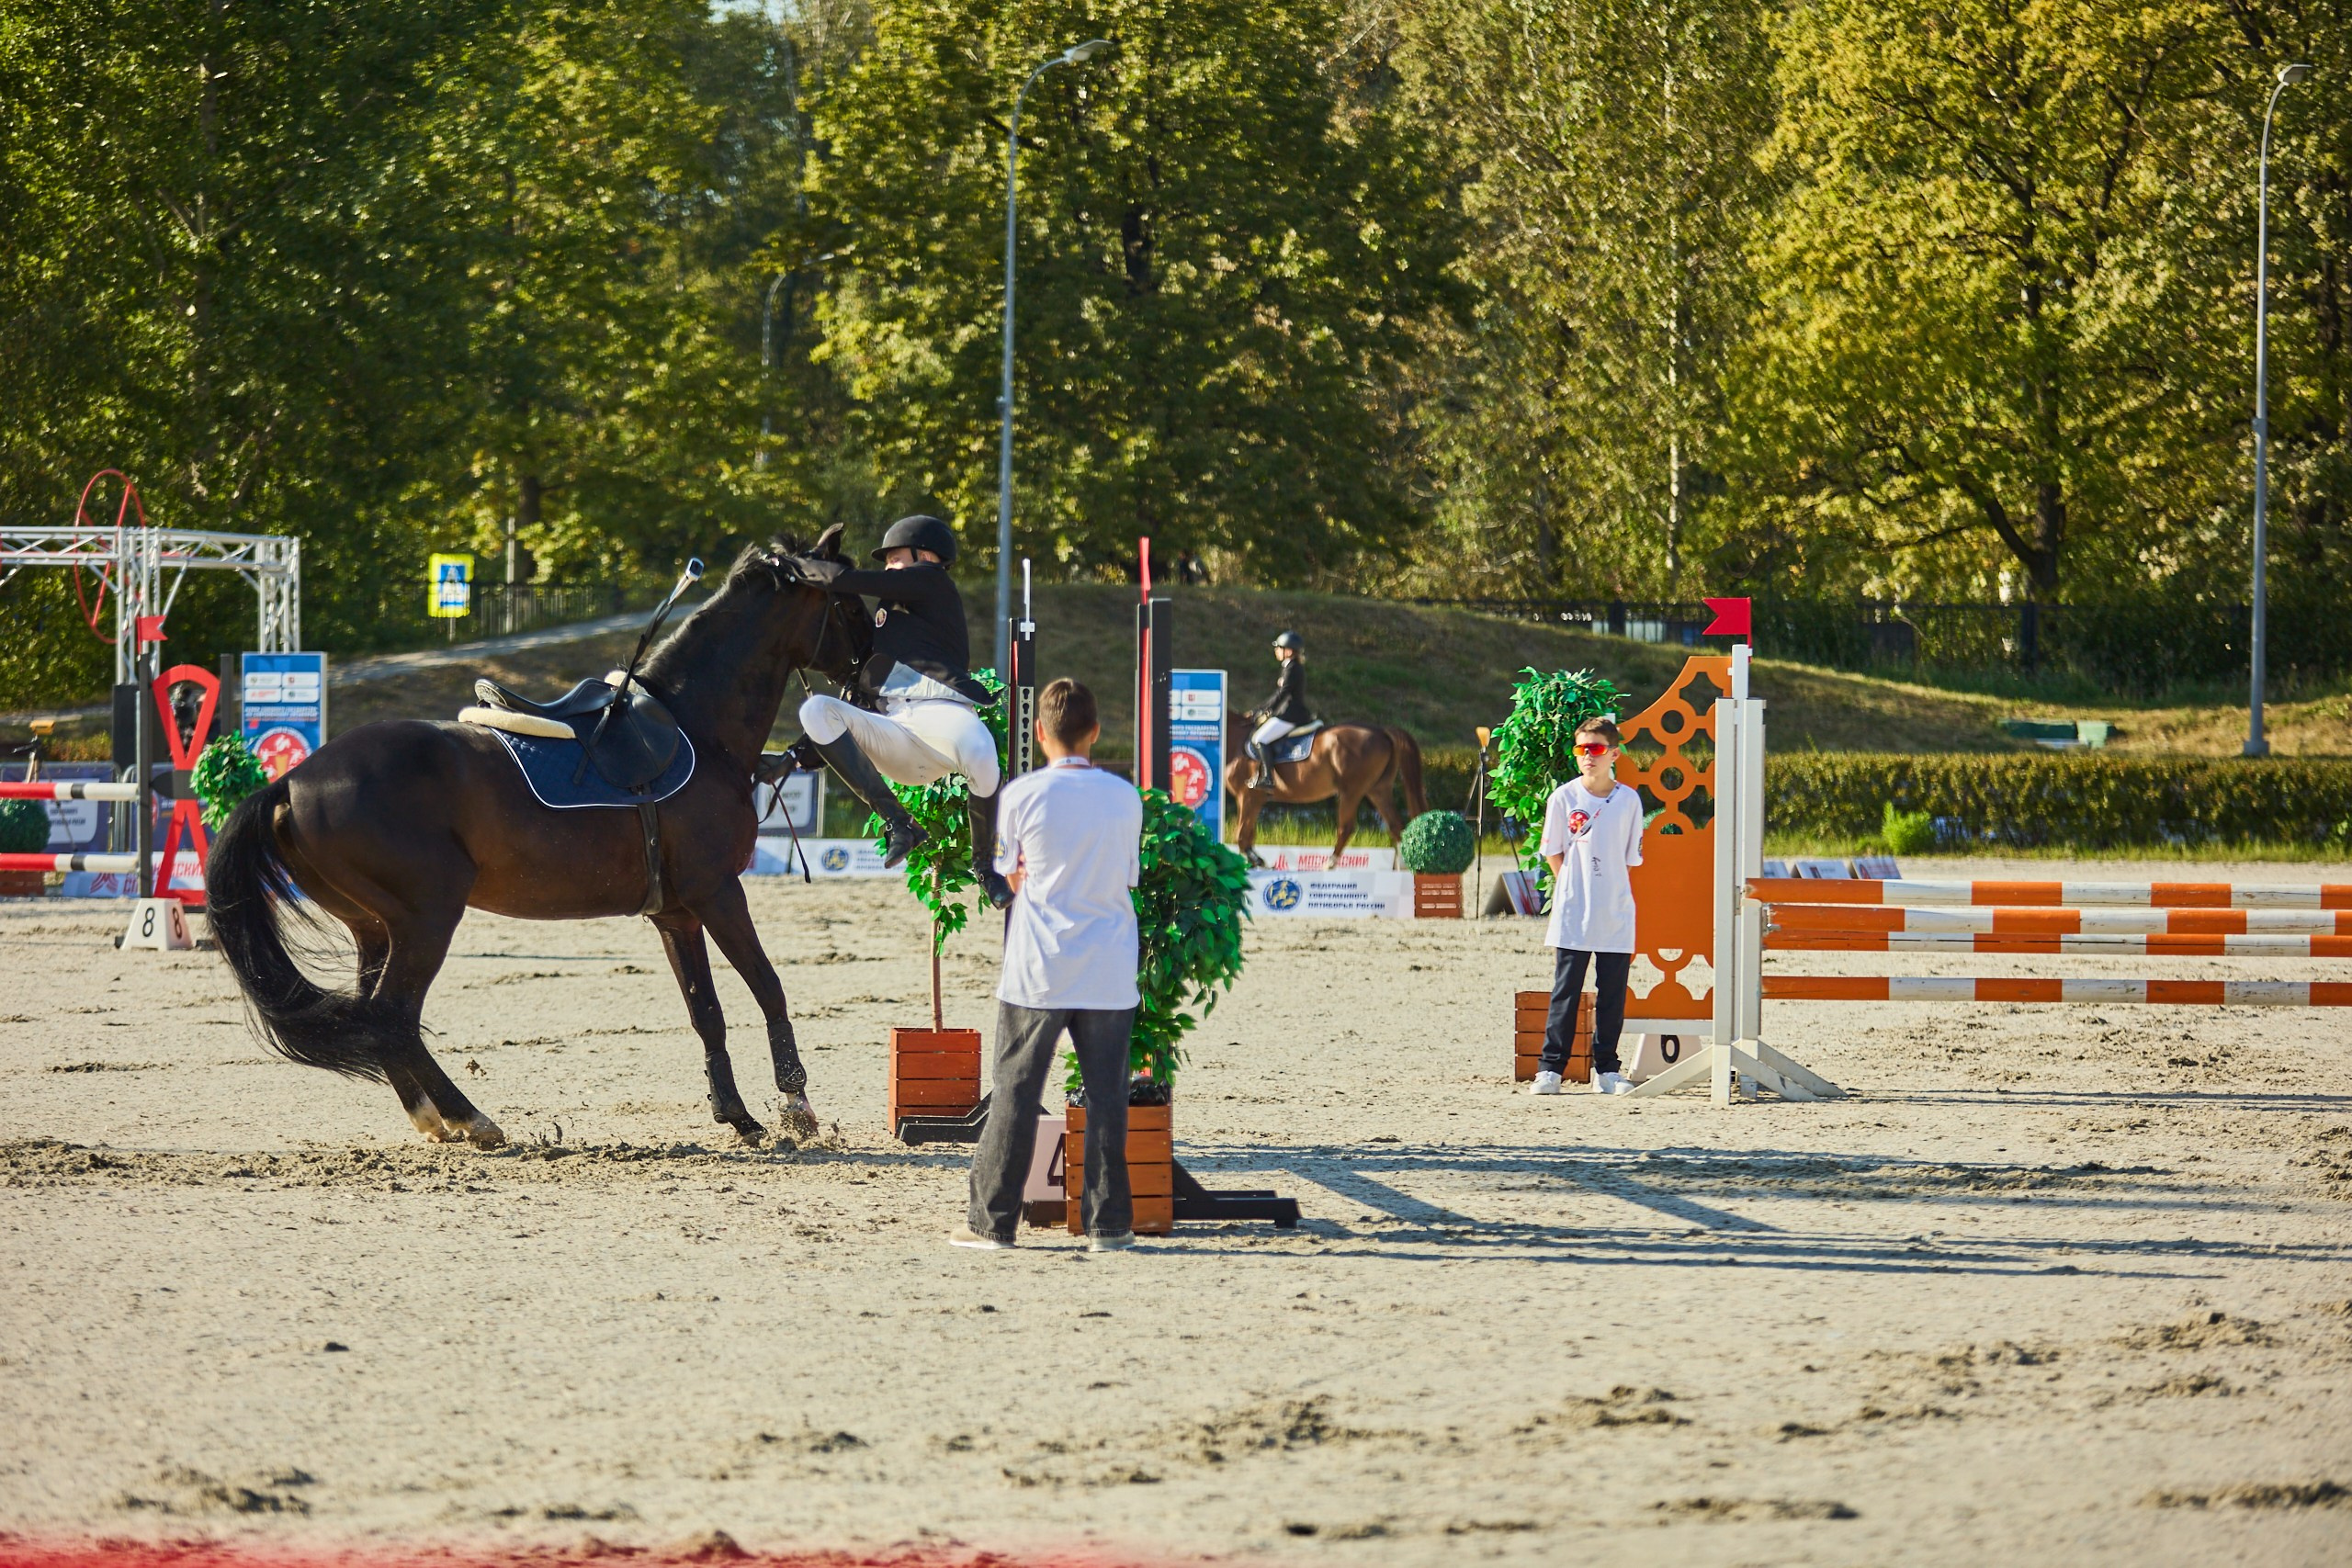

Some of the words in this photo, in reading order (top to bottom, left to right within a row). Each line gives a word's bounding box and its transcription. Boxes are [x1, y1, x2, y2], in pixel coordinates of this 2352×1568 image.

[1297, 853, 1369, 868] МОСКСКИЙ
[1309, 892, 1368, 900] СОВРЕМЕННОГО
[1356, 902, 1385, 910] РОССИИ
[143, 908, 154, 937] 8
[173, 908, 182, 938] 8
